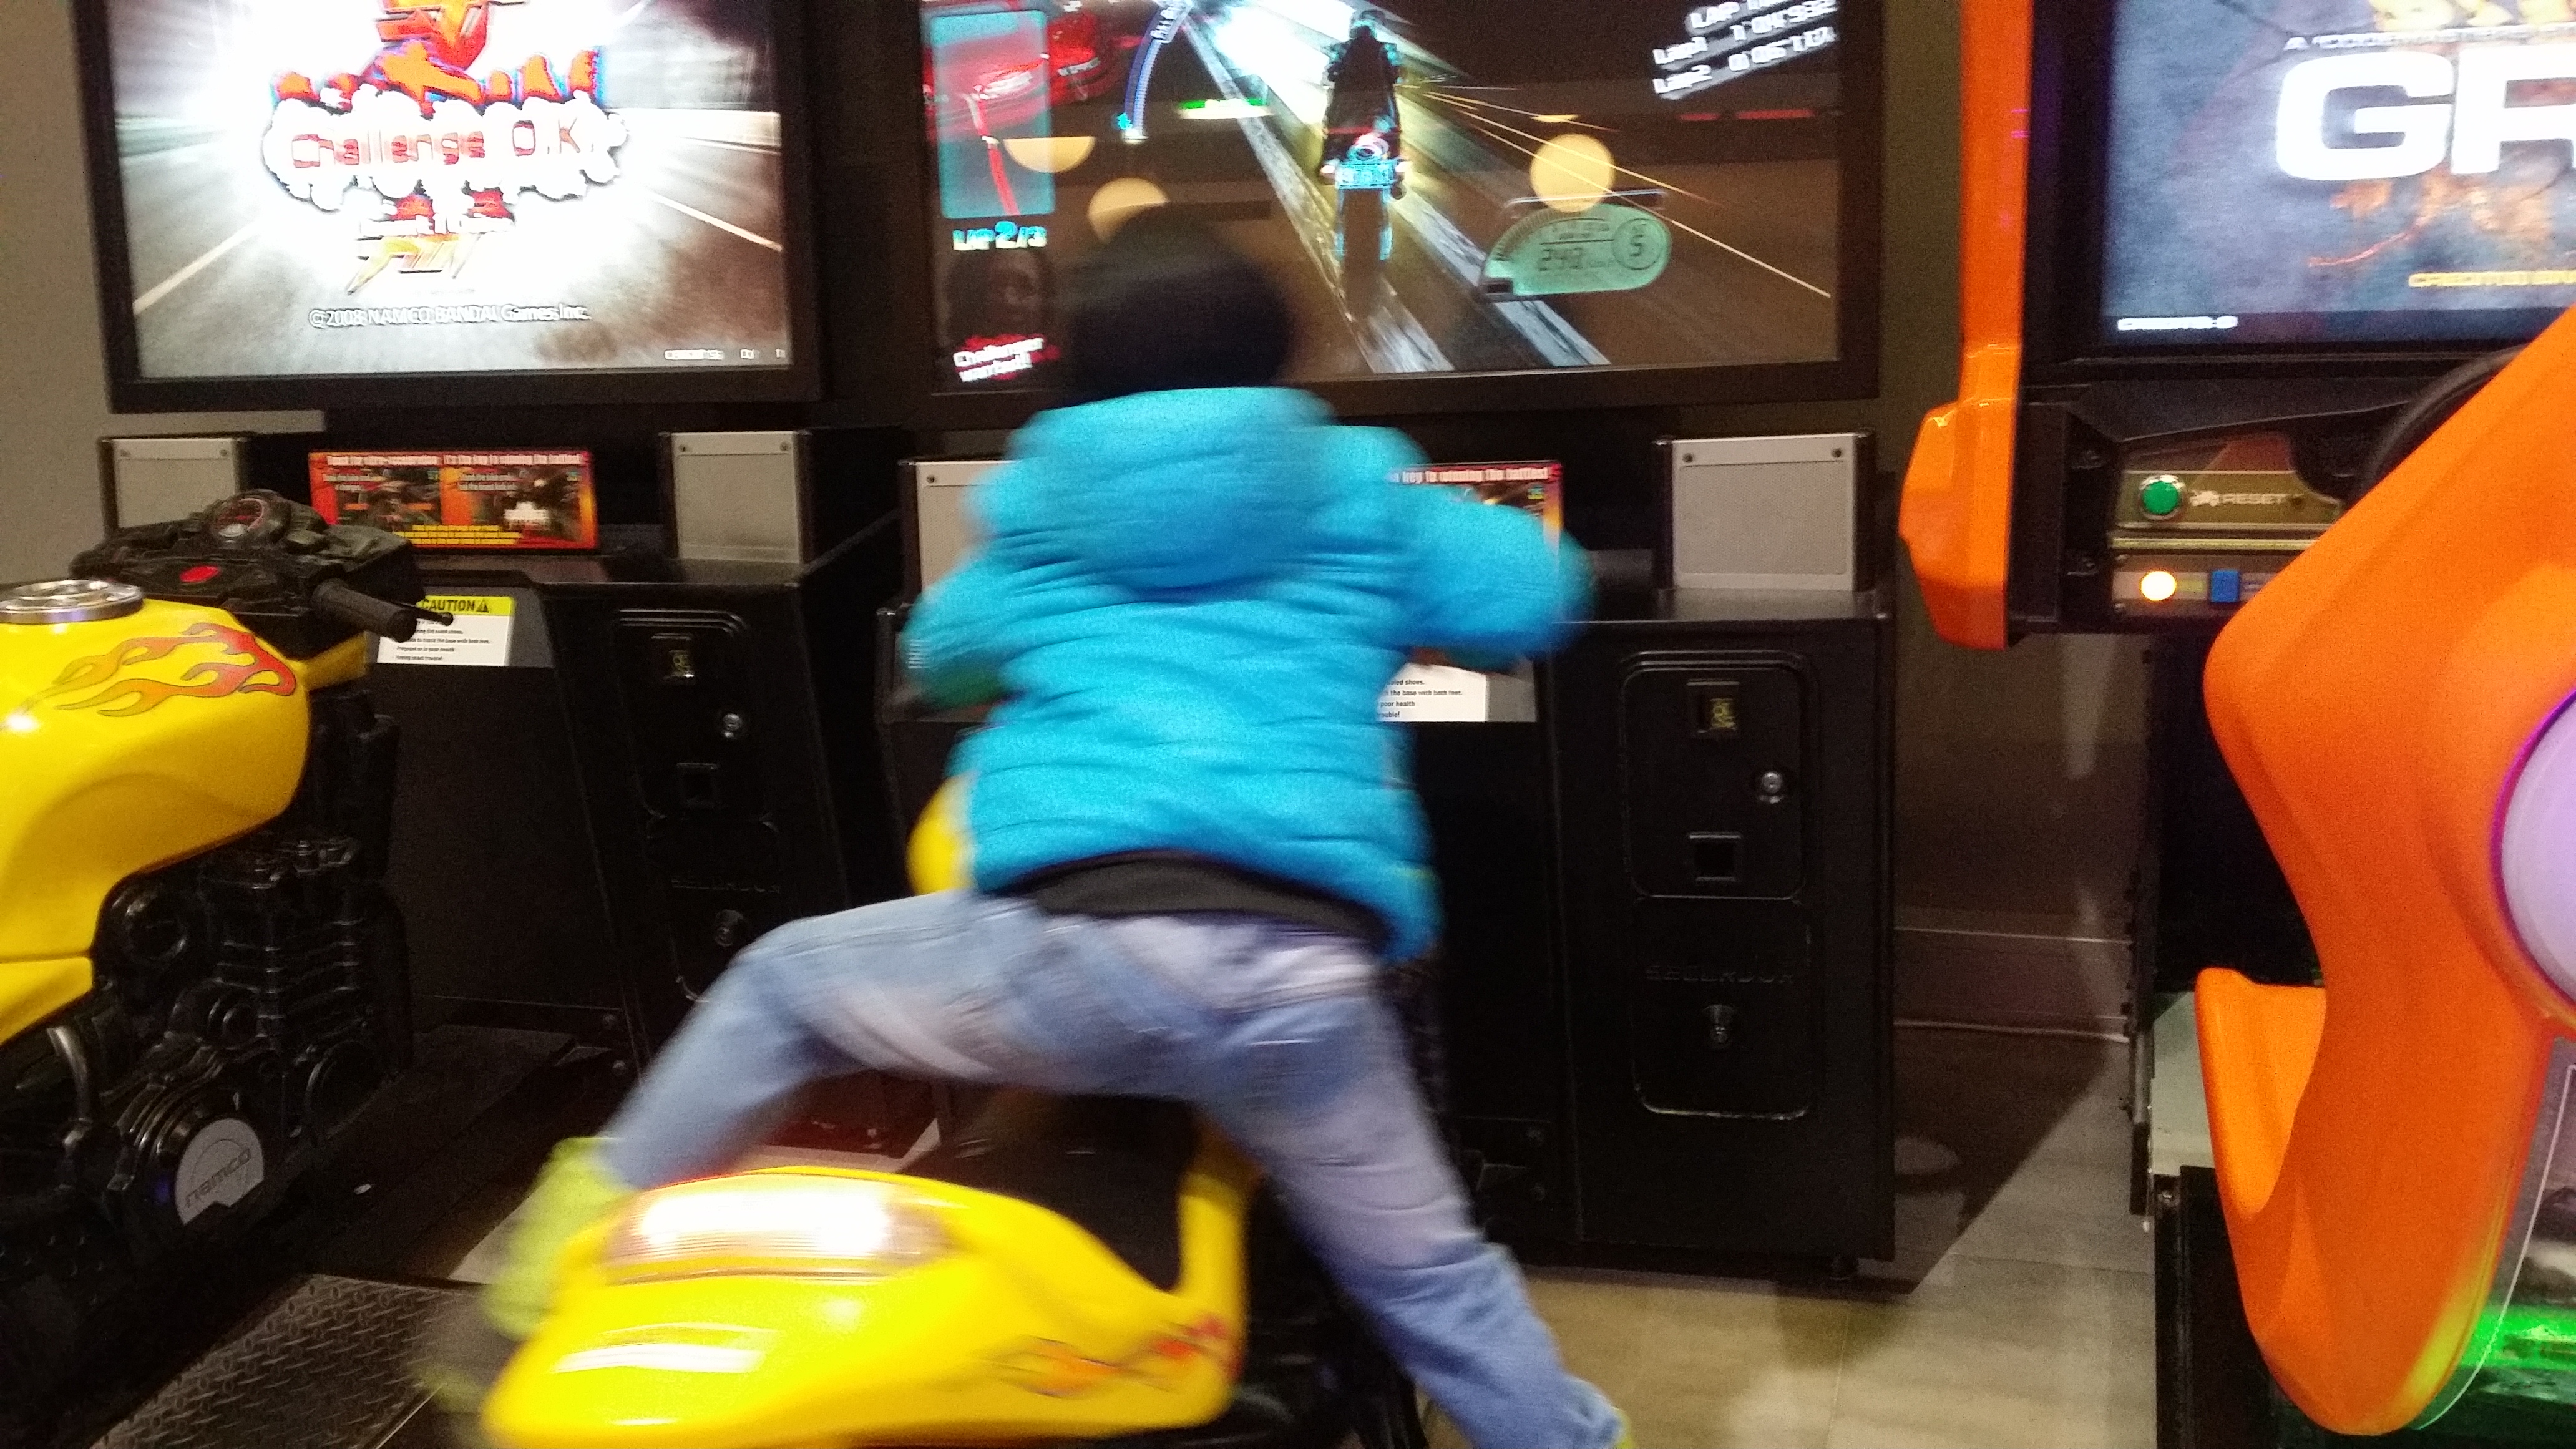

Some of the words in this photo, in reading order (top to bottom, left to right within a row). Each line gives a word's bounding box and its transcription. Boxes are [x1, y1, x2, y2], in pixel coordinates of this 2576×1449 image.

[291, 129, 485, 168] Challenge
[368, 306, 435, 325] NAMCO
[436, 305, 497, 324] BANDAI
[500, 304, 560, 323] Games
[2221, 492, 2289, 504] RESET
[422, 599, 475, 612] CAUTION
[185, 1147, 251, 1209] namco
